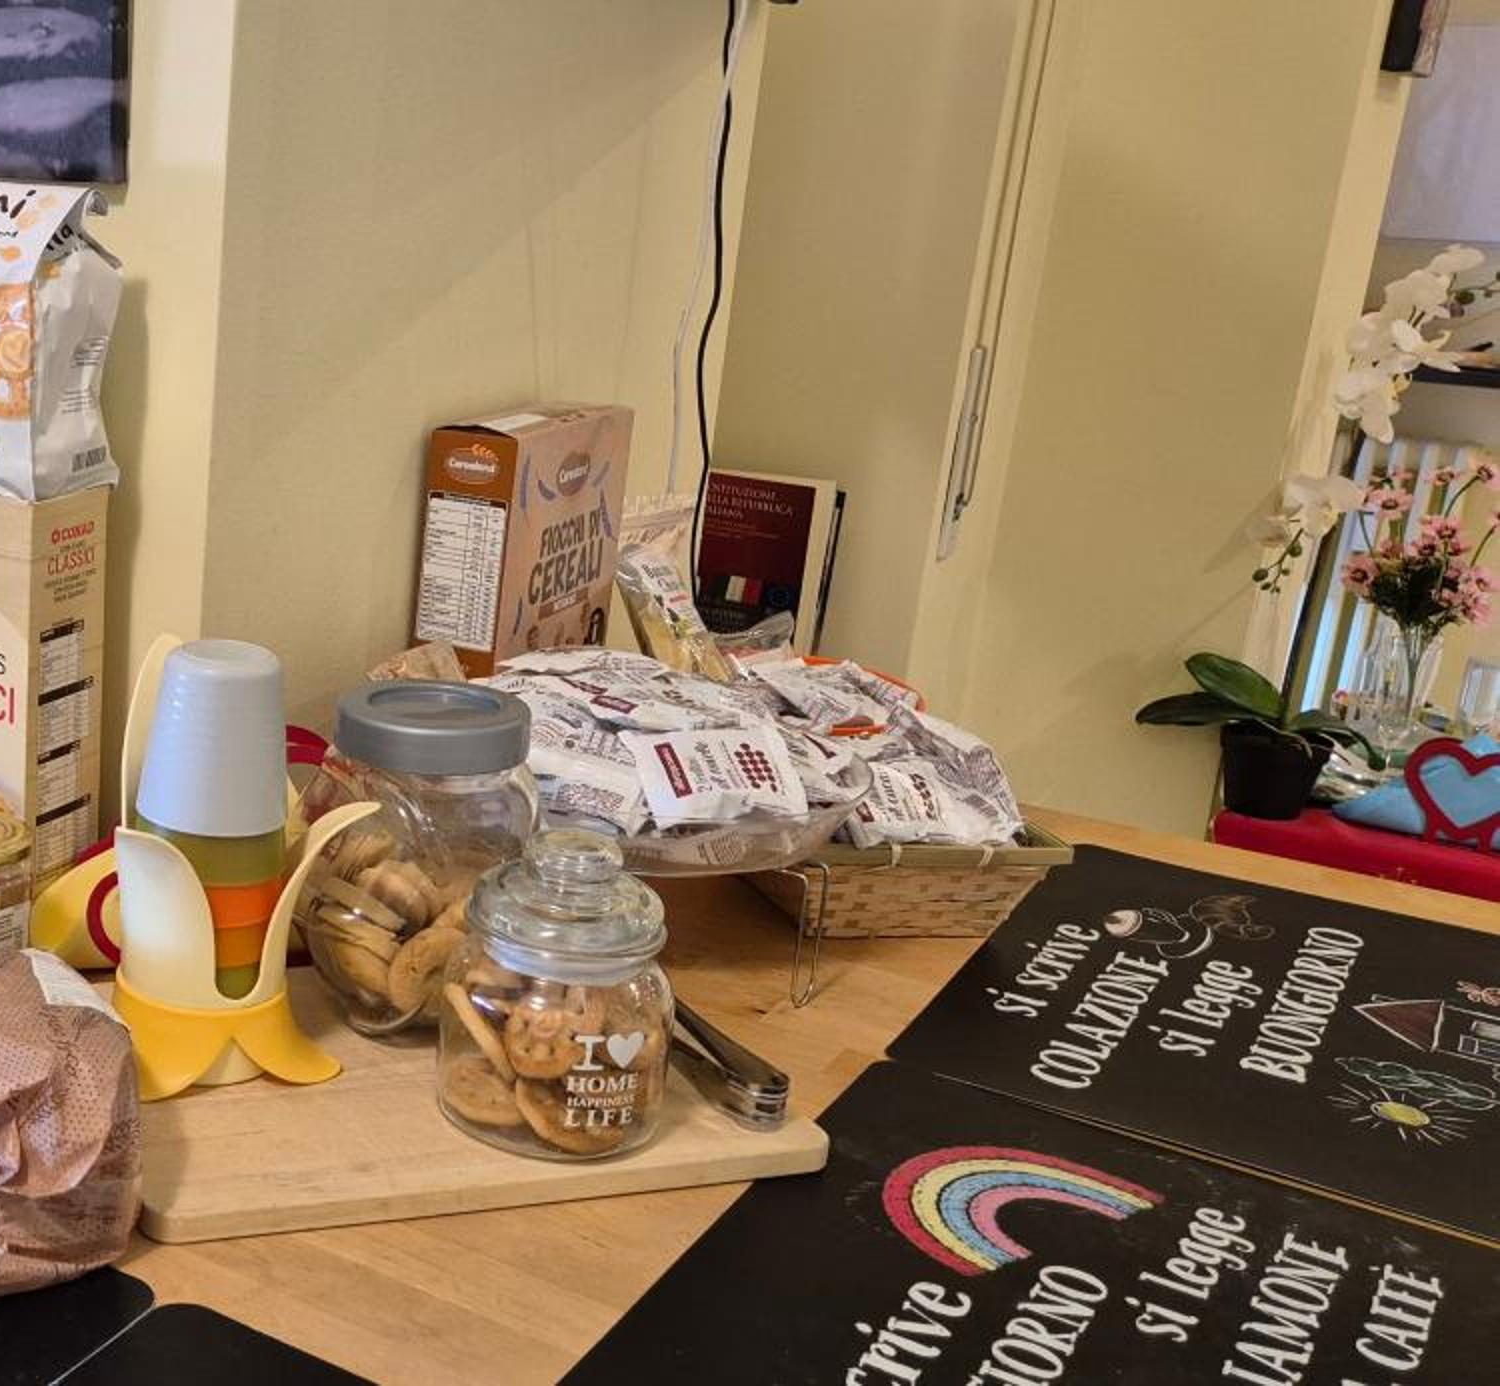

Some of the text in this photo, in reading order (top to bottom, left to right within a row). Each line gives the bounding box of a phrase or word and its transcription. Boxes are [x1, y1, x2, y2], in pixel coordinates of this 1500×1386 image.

[527, 538, 604, 605] CEREALI
[993, 921, 1100, 1018] si scrive
[1148, 958, 1264, 1057] si legge
[1238, 926, 1366, 1085] BUONGIORNO
[571, 1034, 607, 1071] I
[1029, 951, 1173, 1090] COLAZIONE
[563, 1105, 634, 1129] LIFE
[565, 1072, 639, 1093] HOME
[566, 1094, 635, 1108] HAPPINESS
[1126, 1206, 1256, 1344] si legge
